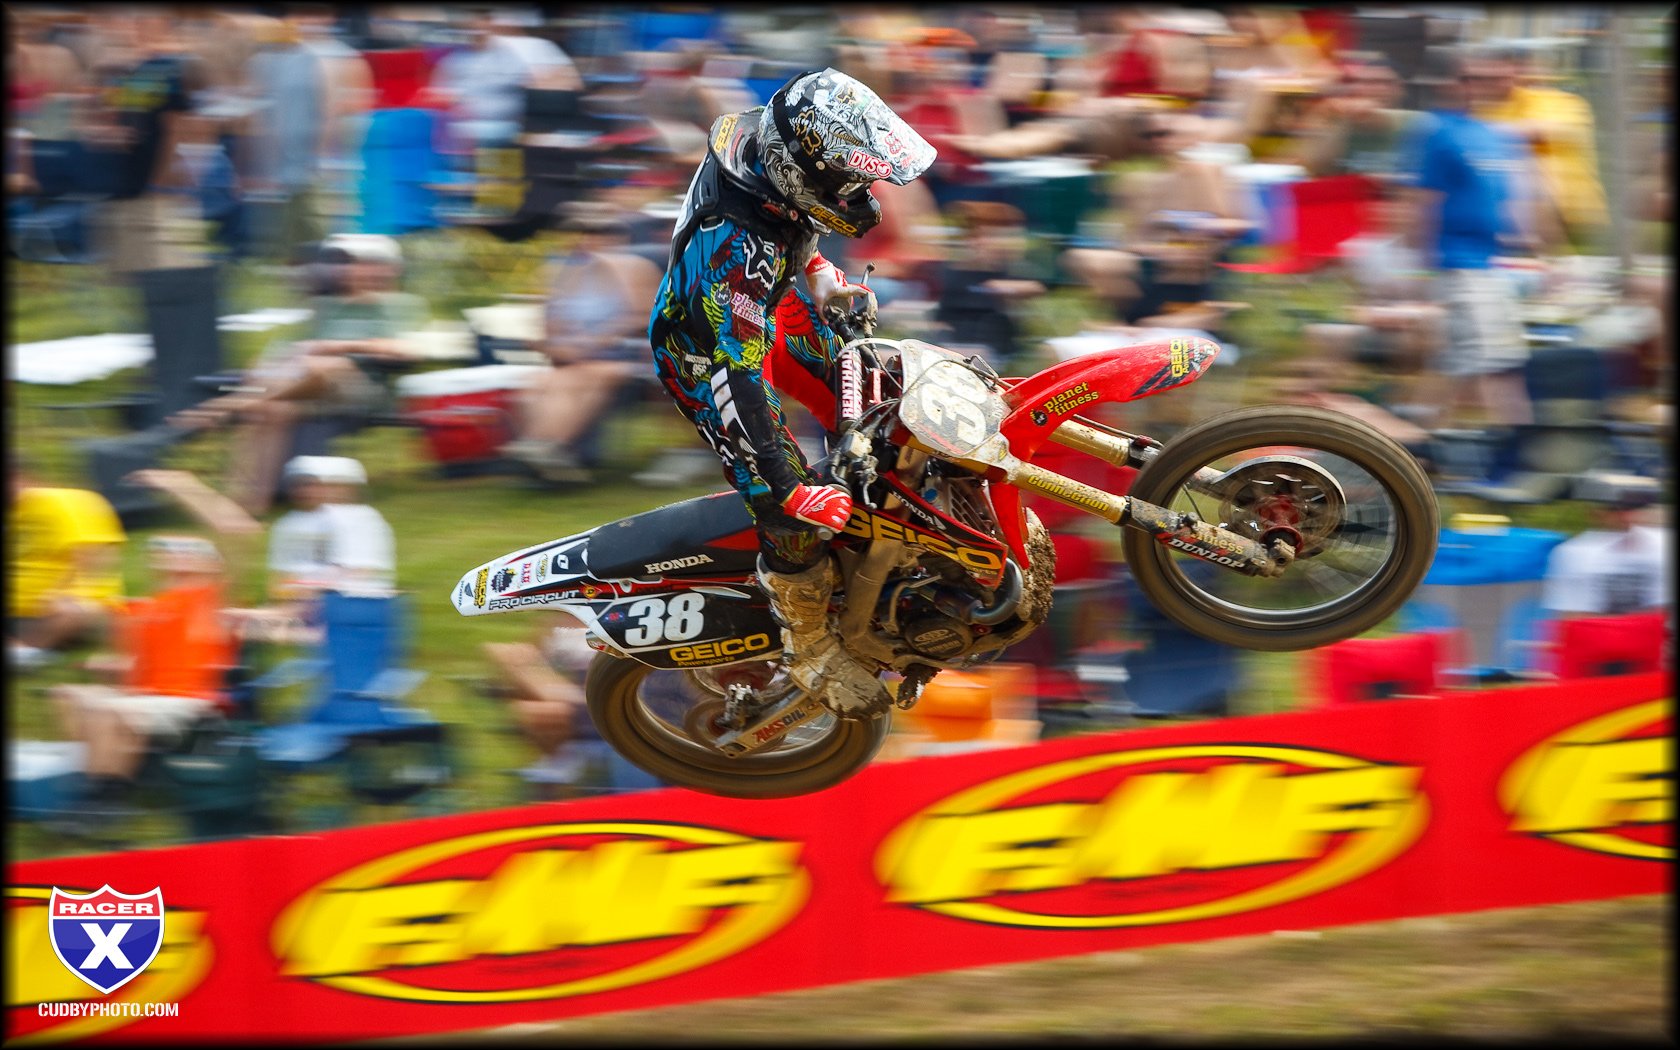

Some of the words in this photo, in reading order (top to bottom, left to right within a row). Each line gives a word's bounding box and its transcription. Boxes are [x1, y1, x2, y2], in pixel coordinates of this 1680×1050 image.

[714, 117, 731, 153] GEICO
[850, 151, 878, 173] DVS
[810, 206, 858, 233] GEICO
[733, 292, 766, 316] plan
[734, 303, 766, 327] fitnes
[842, 351, 854, 418] RENTHAL
[1044, 382, 1089, 412] planet
[1055, 391, 1100, 416] fitness
[844, 506, 1002, 570] GEICO
[645, 554, 714, 574] HONDA
[1169, 539, 1246, 568] DUNLOP
[625, 592, 705, 647] 38
[669, 633, 770, 662] GEICO
[886, 764, 1424, 905] FMF
[281, 841, 805, 977] FMF
